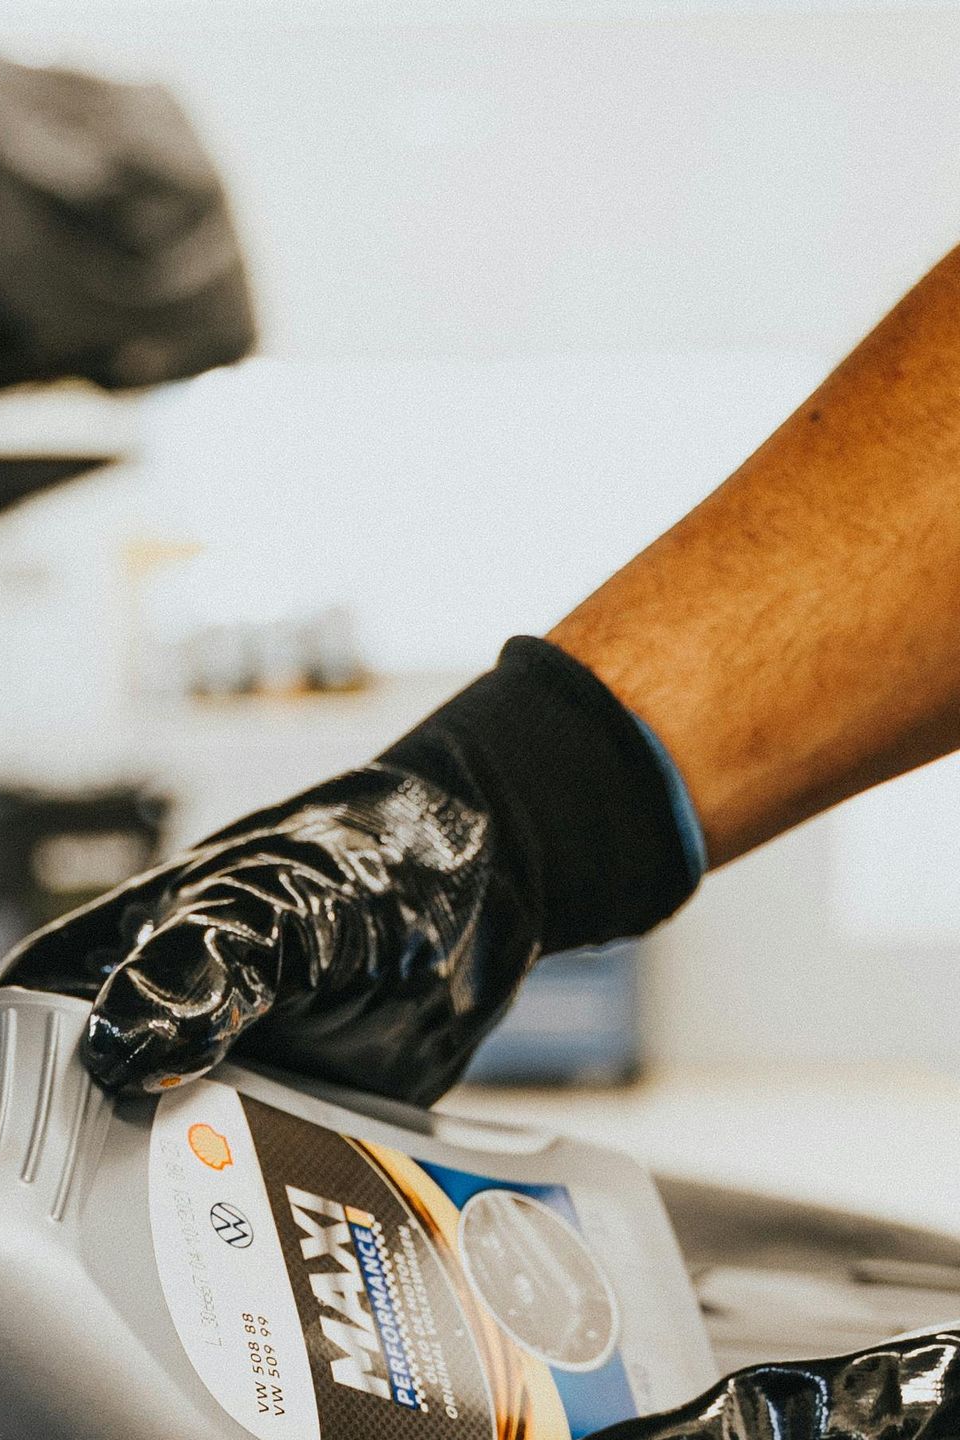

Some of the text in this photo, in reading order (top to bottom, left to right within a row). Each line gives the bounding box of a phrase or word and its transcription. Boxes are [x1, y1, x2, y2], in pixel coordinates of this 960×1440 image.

[285, 1185, 393, 1401] MAXI
[354, 1228, 416, 1408] PERFORMANCE
[393, 1252, 420, 1312] MOTOR
[397, 1224, 458, 1419] ORIGINAL VOLKSWAGEN
[241, 1313, 270, 1414] VW 508 88
[256, 1316, 285, 1416] VW 509 99
